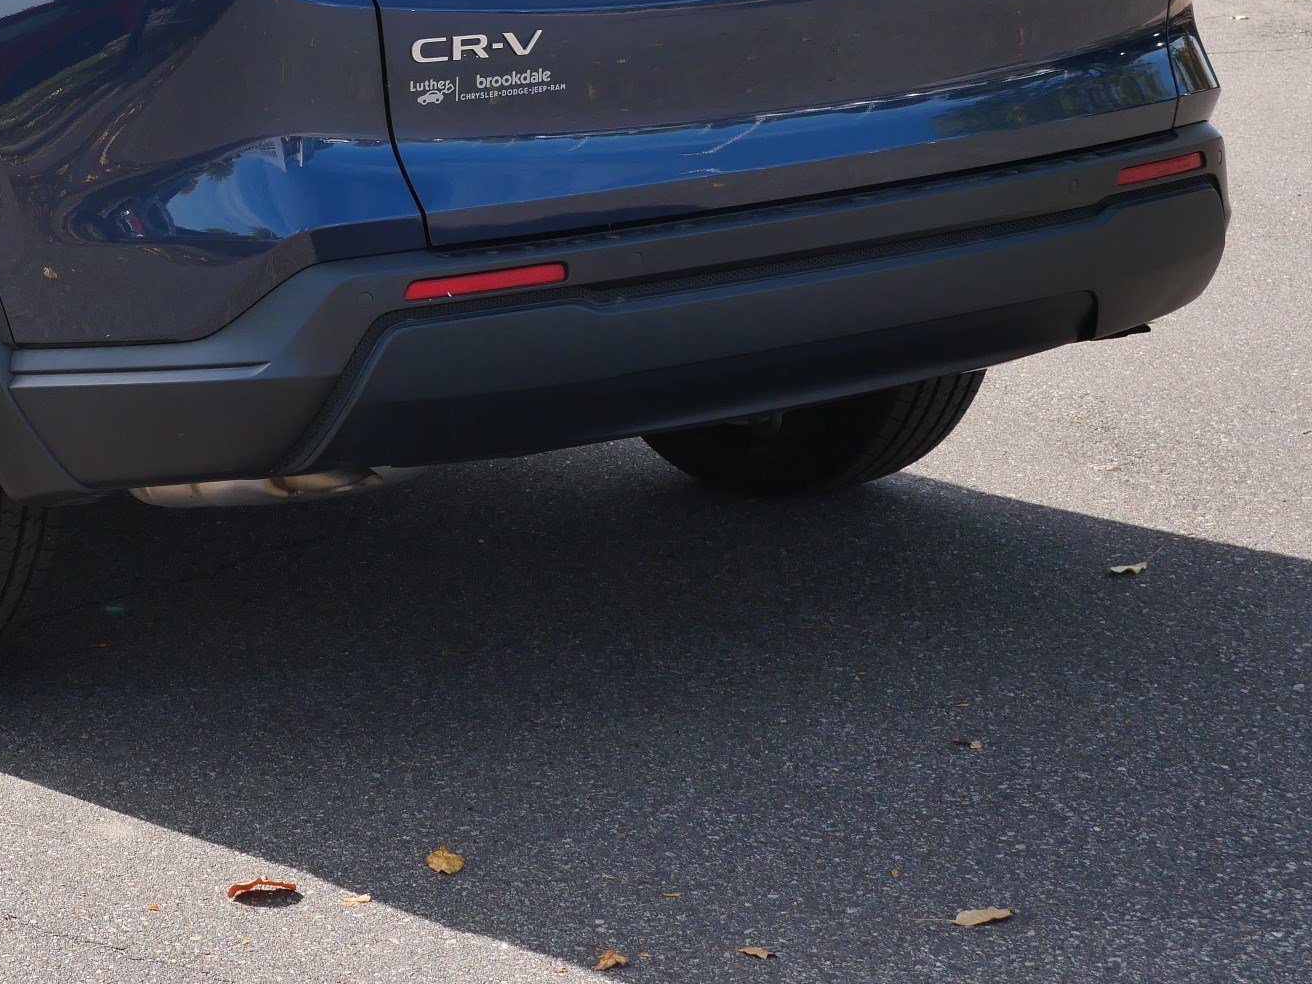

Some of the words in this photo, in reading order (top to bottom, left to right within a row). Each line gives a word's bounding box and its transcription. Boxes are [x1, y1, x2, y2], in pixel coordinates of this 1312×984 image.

[410, 29, 543, 64] CR-V
[410, 78, 451, 92] Luther
[476, 68, 552, 89] brookdale
